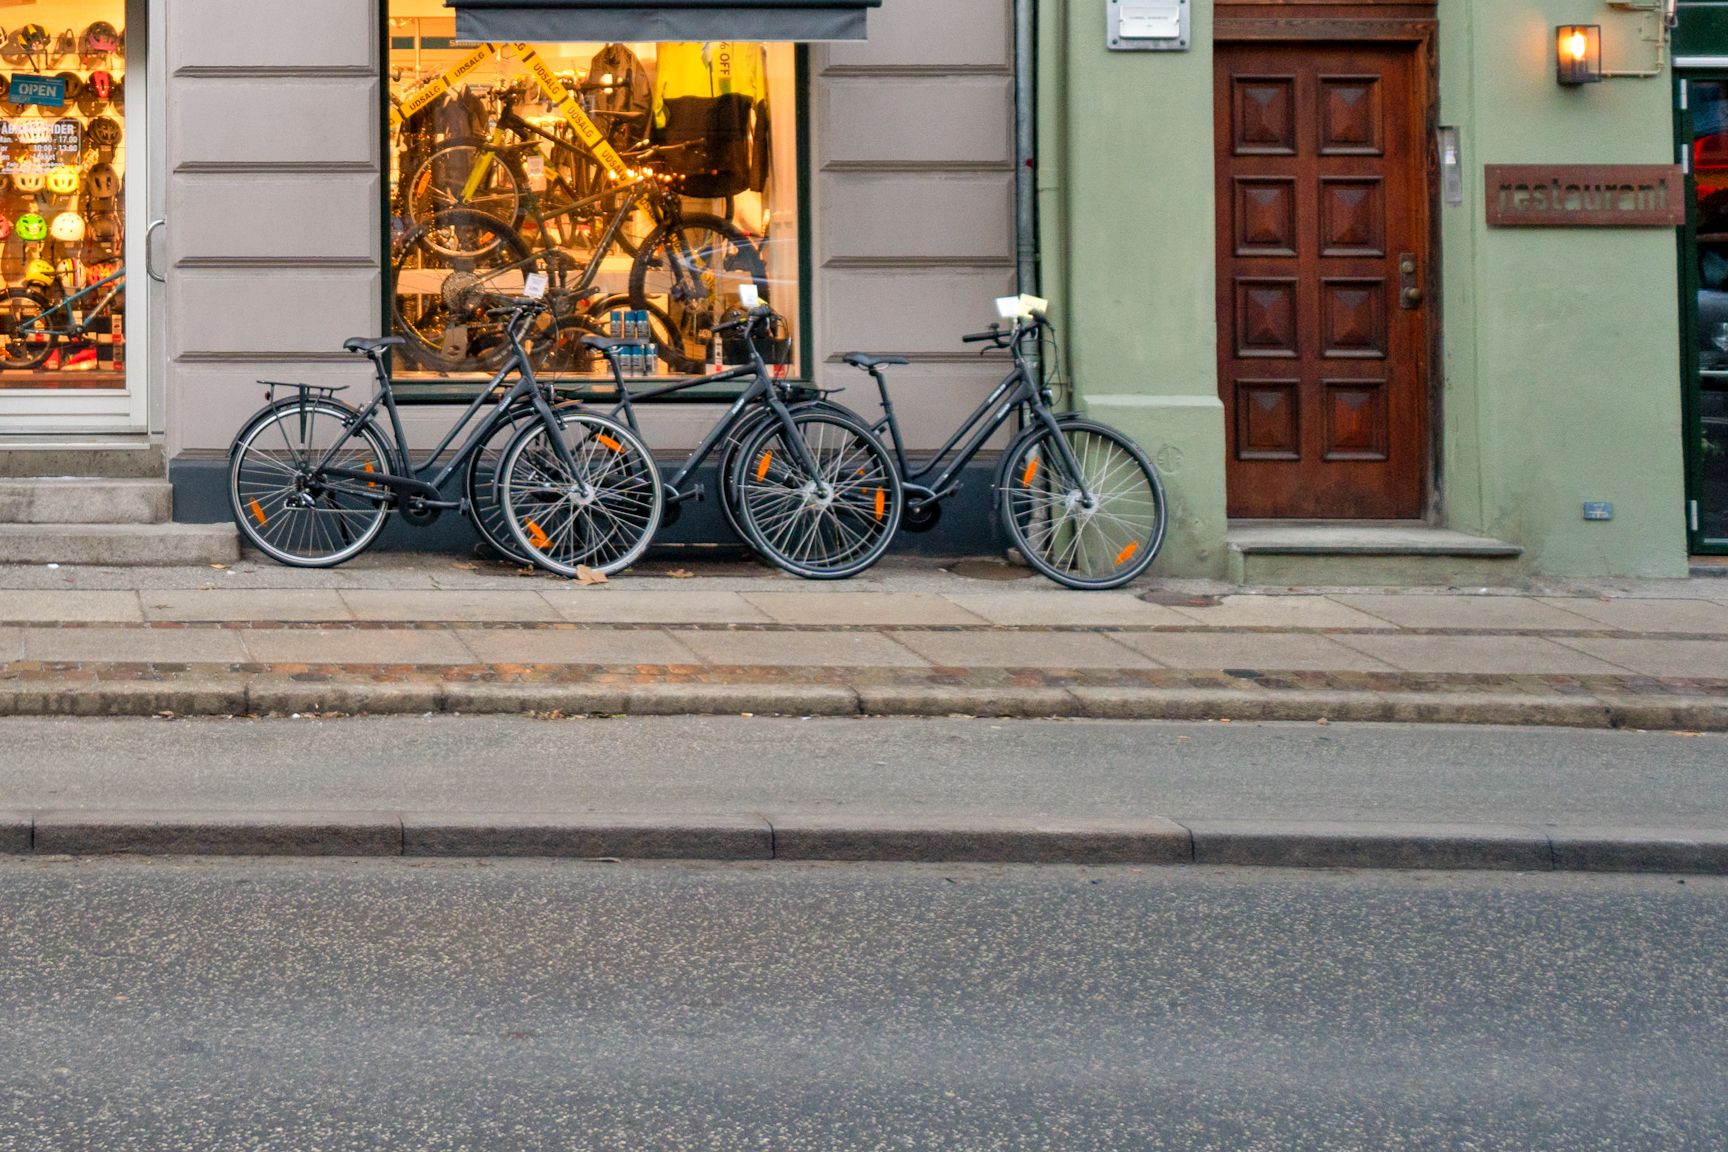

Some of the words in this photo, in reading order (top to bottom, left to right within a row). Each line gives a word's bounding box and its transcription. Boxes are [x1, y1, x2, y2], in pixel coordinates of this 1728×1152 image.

[454, 51, 485, 78] UDSALG
[720, 53, 730, 76] OFF
[18, 83, 57, 97] OPEN
[533, 62, 560, 96] UDSALG
[409, 85, 441, 111] UDSALG
[567, 107, 594, 138] UDSALG
[1498, 177, 1668, 210] restaurant
